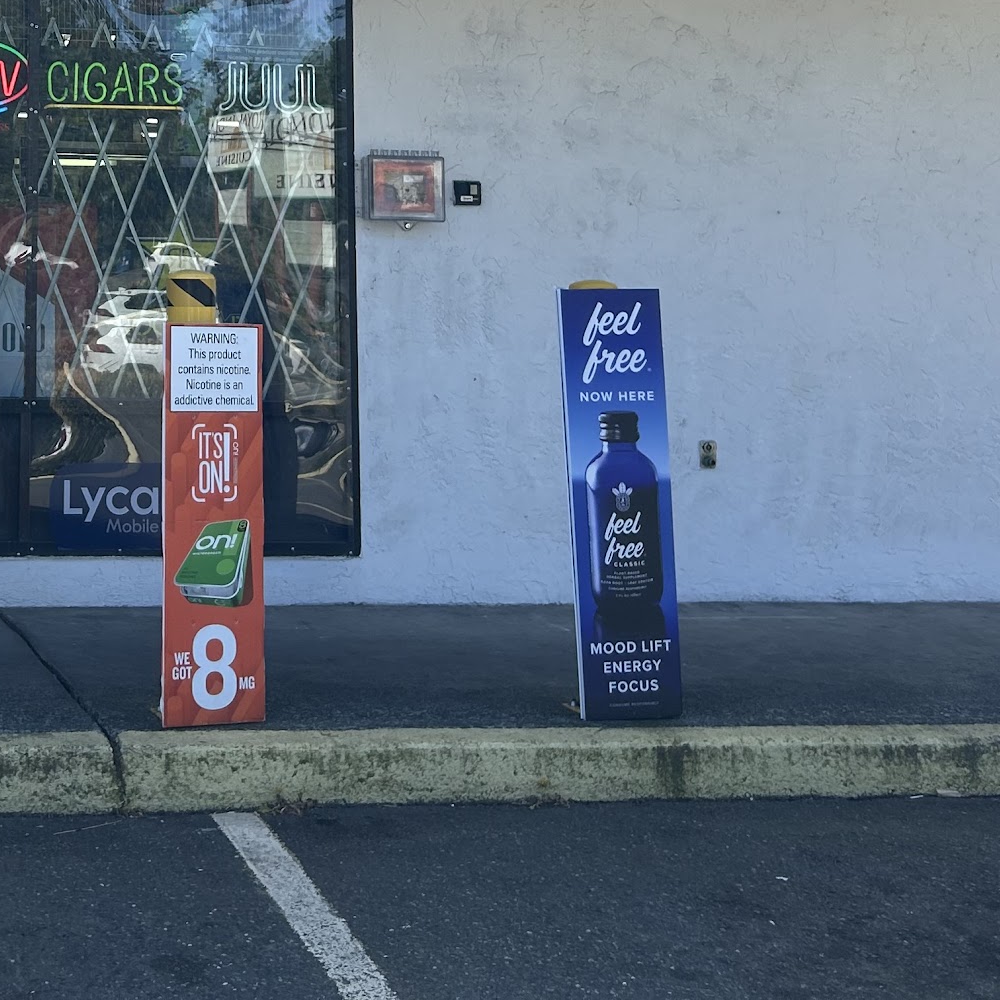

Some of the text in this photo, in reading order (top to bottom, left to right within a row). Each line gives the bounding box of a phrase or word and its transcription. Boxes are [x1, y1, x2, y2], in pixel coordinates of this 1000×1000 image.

[46, 60, 184, 105] CIGARS
[219, 61, 324, 114] JUUL
[582, 302, 642, 347] feel
[190, 332, 238, 344] WARNING:
[188, 348, 242, 361] This product
[582, 340, 647, 384] free
[178, 364, 250, 375] contains nicotine.
[186, 379, 244, 390] Nicotine is an
[174, 394, 254, 406] addictive chemical.
[580, 390, 655, 402] NOW HERE
[198, 432, 223, 460] IT'S
[63, 480, 159, 522] Lyca
[106, 518, 158, 533] Mobile
[604, 511, 642, 540] feel
[195, 534, 238, 550] on!
[604, 536, 645, 565] free
[614, 560, 646, 568] CLASSIC
[590, 639, 672, 654] MOOD LIFT
[174, 652, 190, 665] WE
[603, 658, 662, 674] ENERGY
[172, 666, 192, 680] GOT
[192, 624, 238, 710] 8
[239, 676, 256, 690] MG
[608, 679, 659, 694] FOCUS
